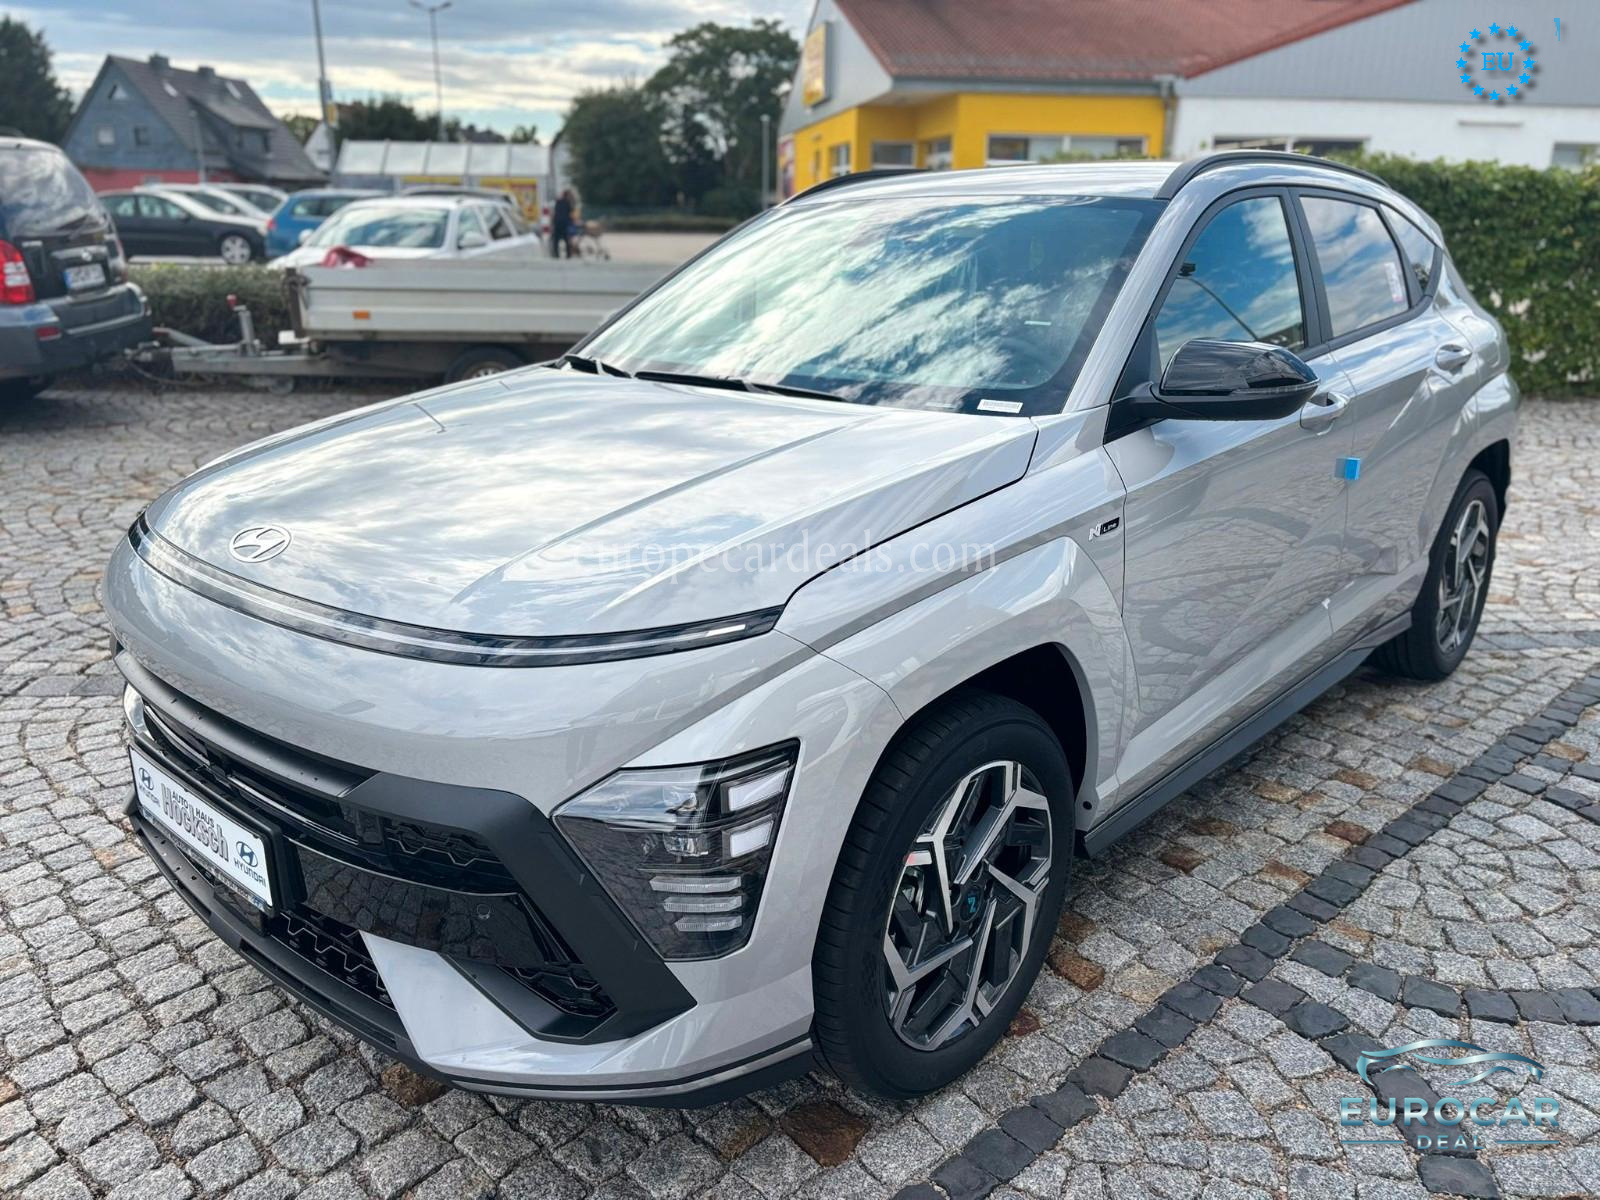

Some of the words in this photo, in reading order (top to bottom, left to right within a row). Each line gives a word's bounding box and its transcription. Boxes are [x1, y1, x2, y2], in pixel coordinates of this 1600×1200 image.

[172, 791, 189, 809] AUTO
[195, 807, 215, 828] HAUS
[234, 859, 267, 887] HYUNDAI
